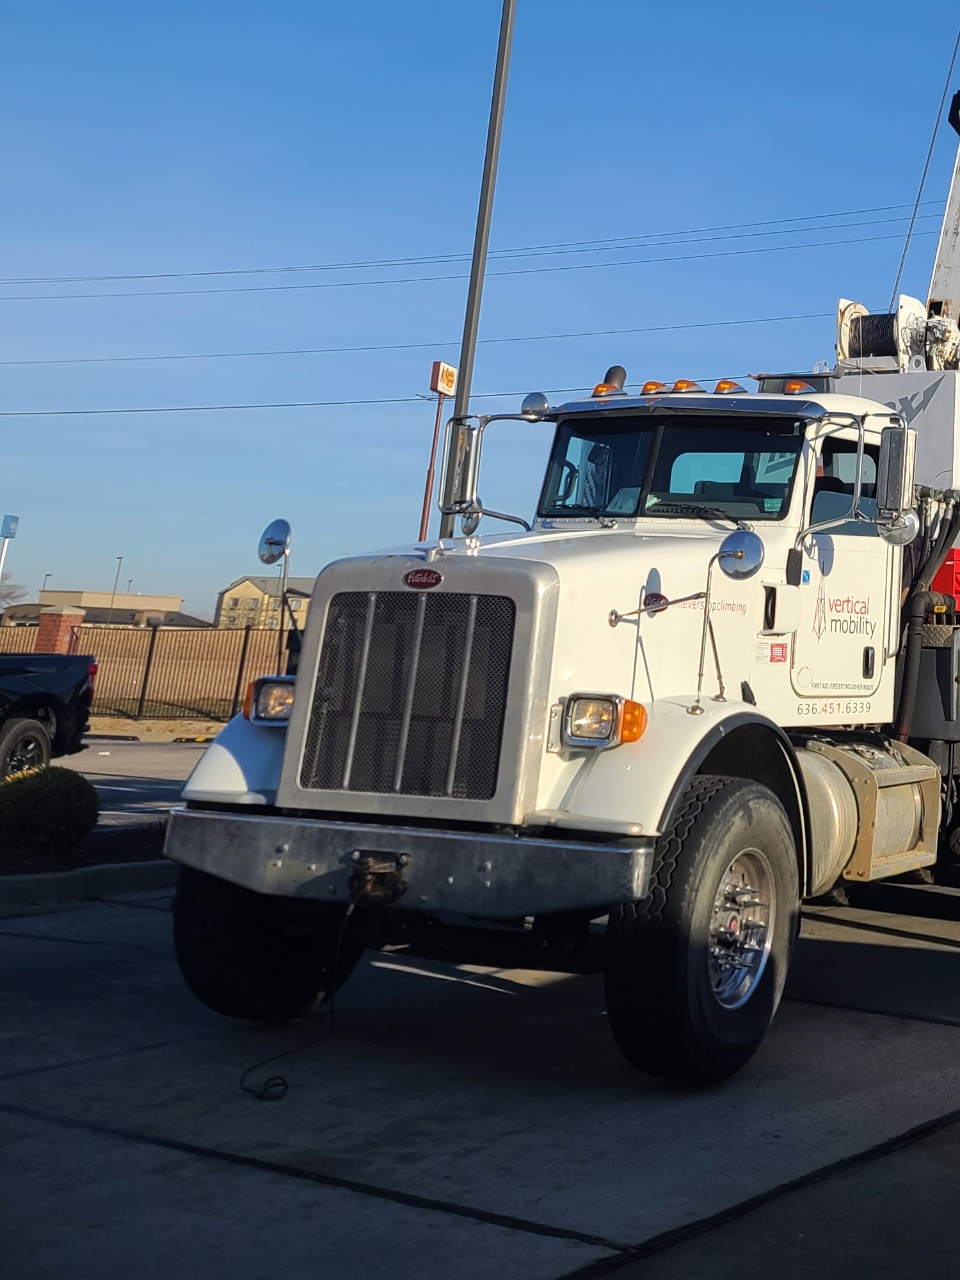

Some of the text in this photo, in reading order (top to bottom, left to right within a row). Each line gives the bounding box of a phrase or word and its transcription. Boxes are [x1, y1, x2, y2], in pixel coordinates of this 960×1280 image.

[677, 599, 747, 615] neversopclimbing
[828, 596, 869, 615] vertical
[830, 615, 877, 639] mobility
[797, 702, 871, 716] 636.451.6339
